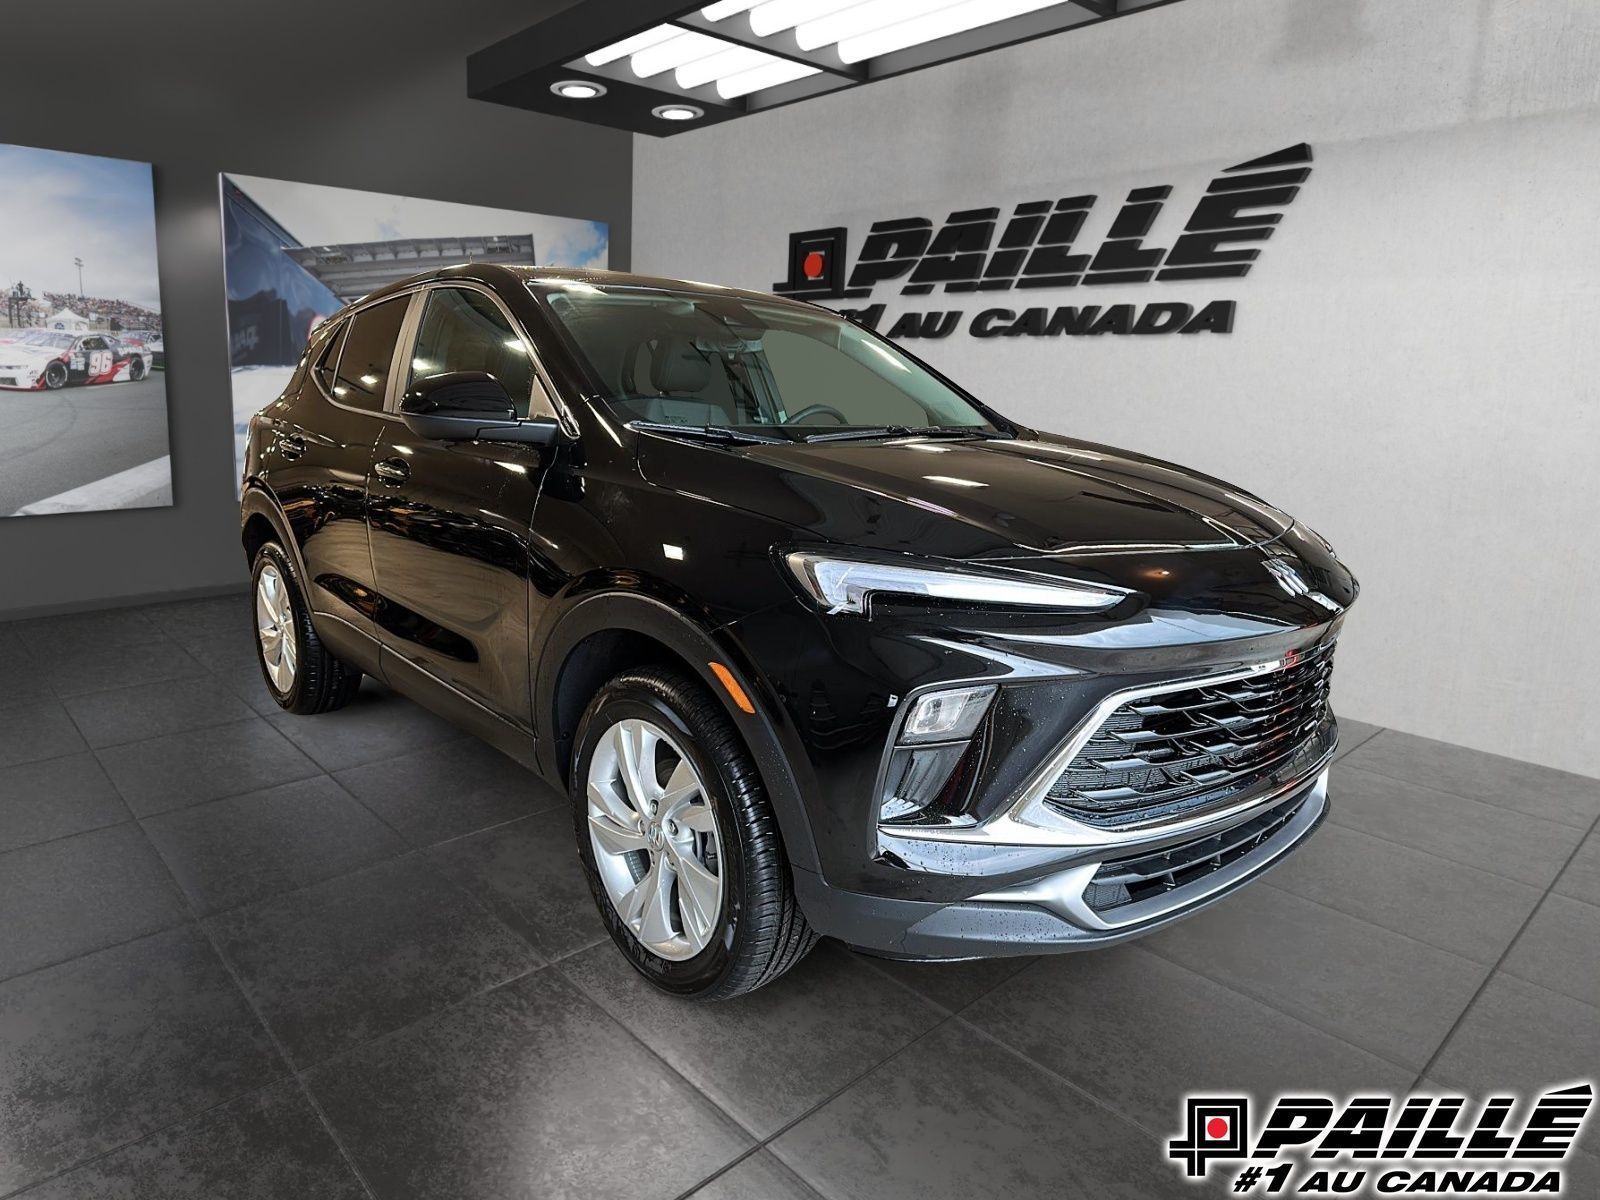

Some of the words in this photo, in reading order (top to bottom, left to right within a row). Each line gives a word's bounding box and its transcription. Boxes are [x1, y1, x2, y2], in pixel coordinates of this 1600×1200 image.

[844, 142, 1313, 297] PAILLÉ
[838, 303, 886, 331] 1
[887, 310, 963, 339] AU
[969, 300, 1237, 339] CANADA
[88, 350, 114, 377] 96
